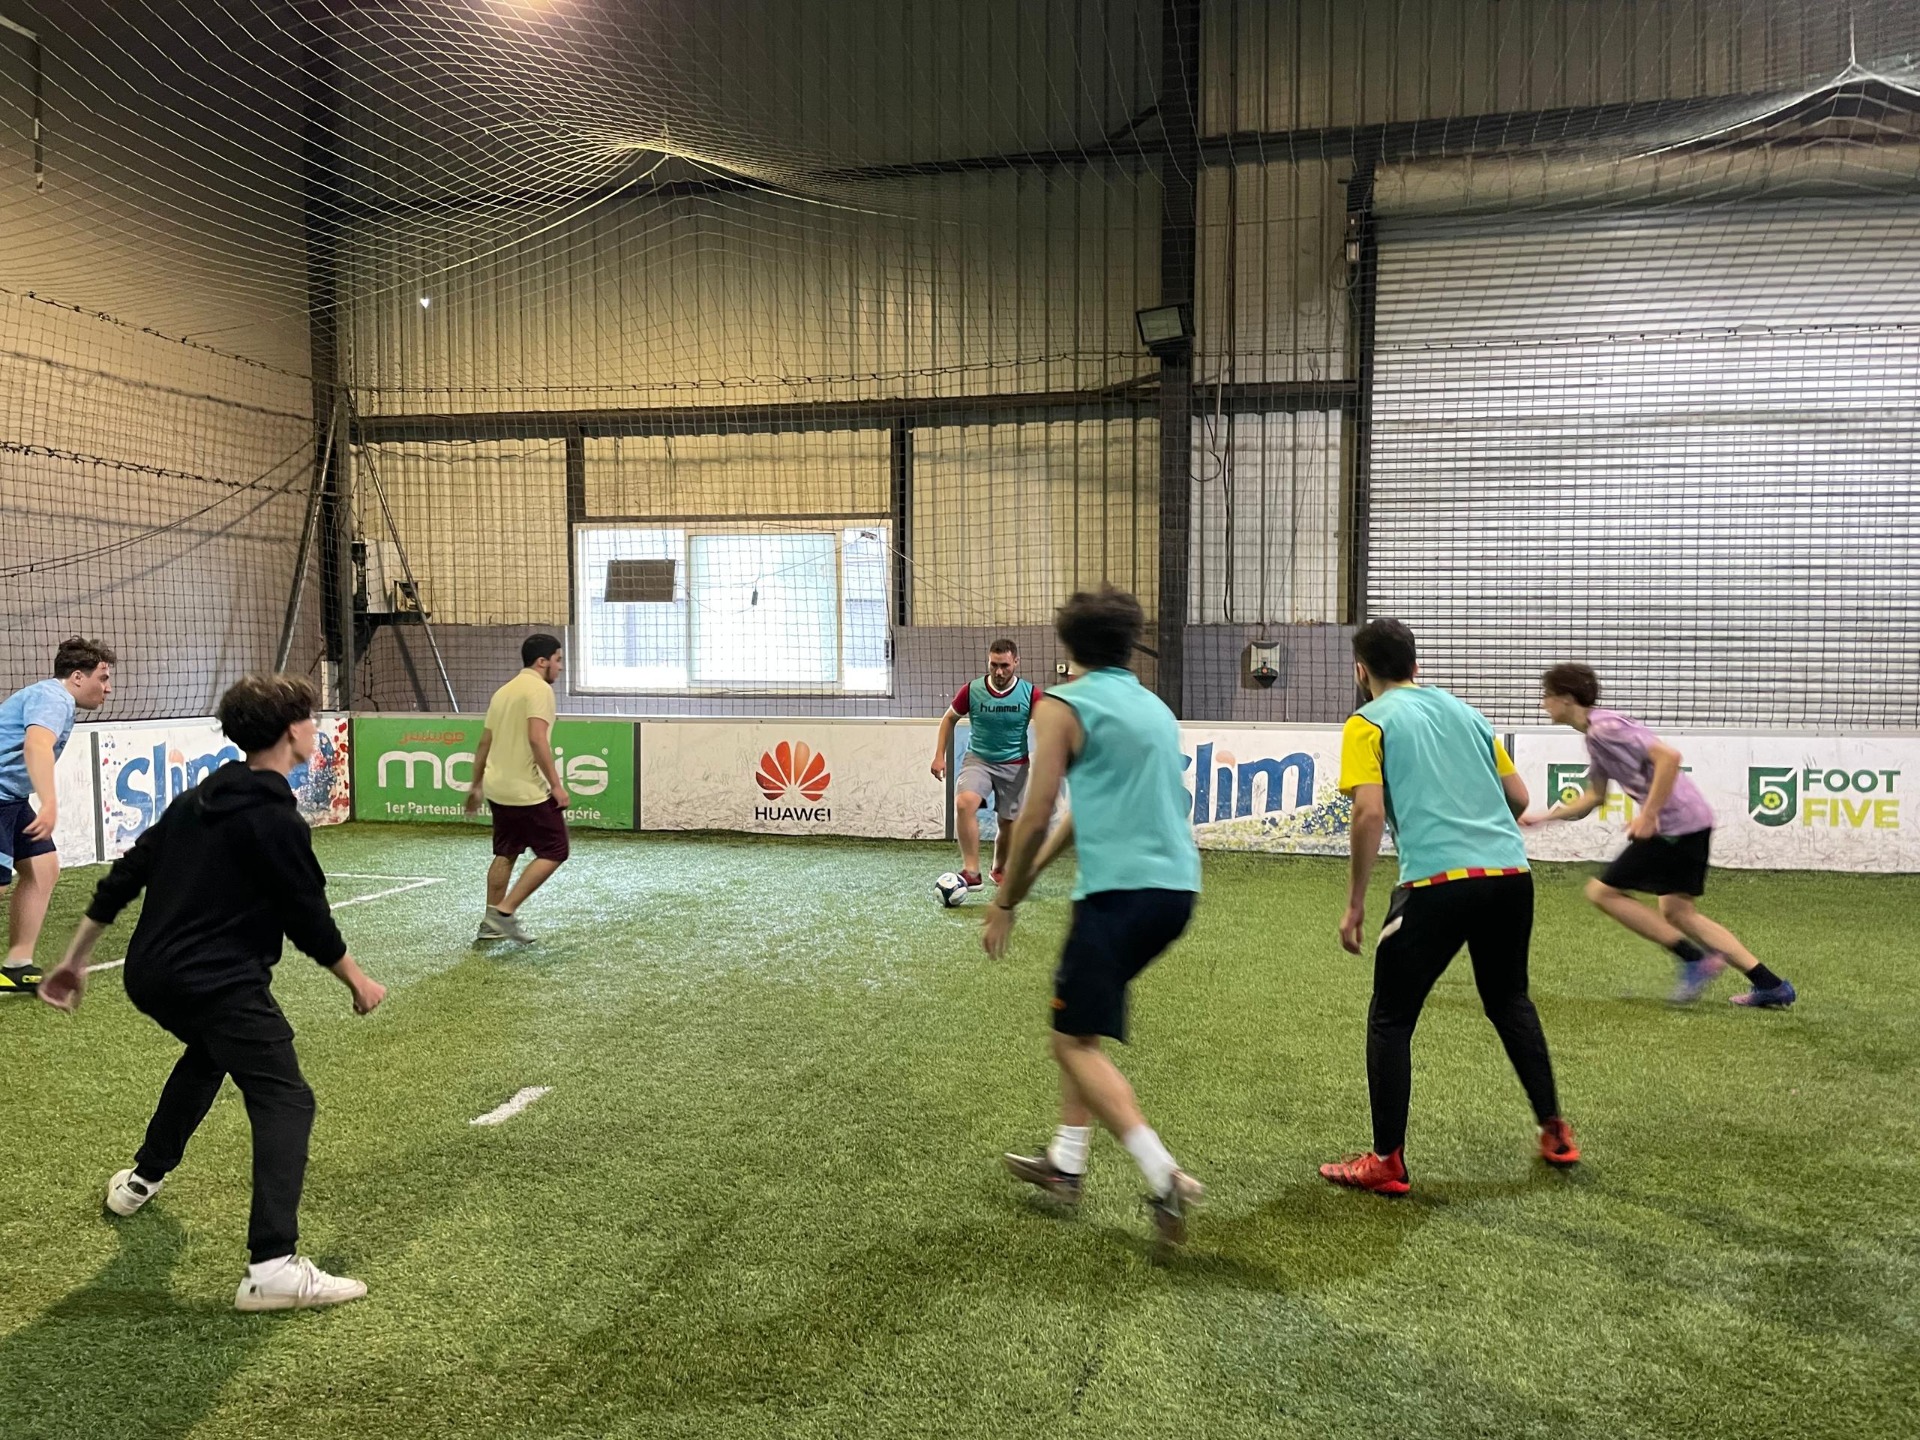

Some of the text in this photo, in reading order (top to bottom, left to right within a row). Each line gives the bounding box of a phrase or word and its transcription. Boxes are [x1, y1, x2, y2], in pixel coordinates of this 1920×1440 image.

[980, 702, 1021, 713] hummel
[377, 746, 609, 796] mois
[1802, 768, 1901, 793] FOOT
[385, 801, 405, 814] 1er
[755, 806, 831, 822] HUAWEI
[1802, 797, 1900, 828] FIVE
